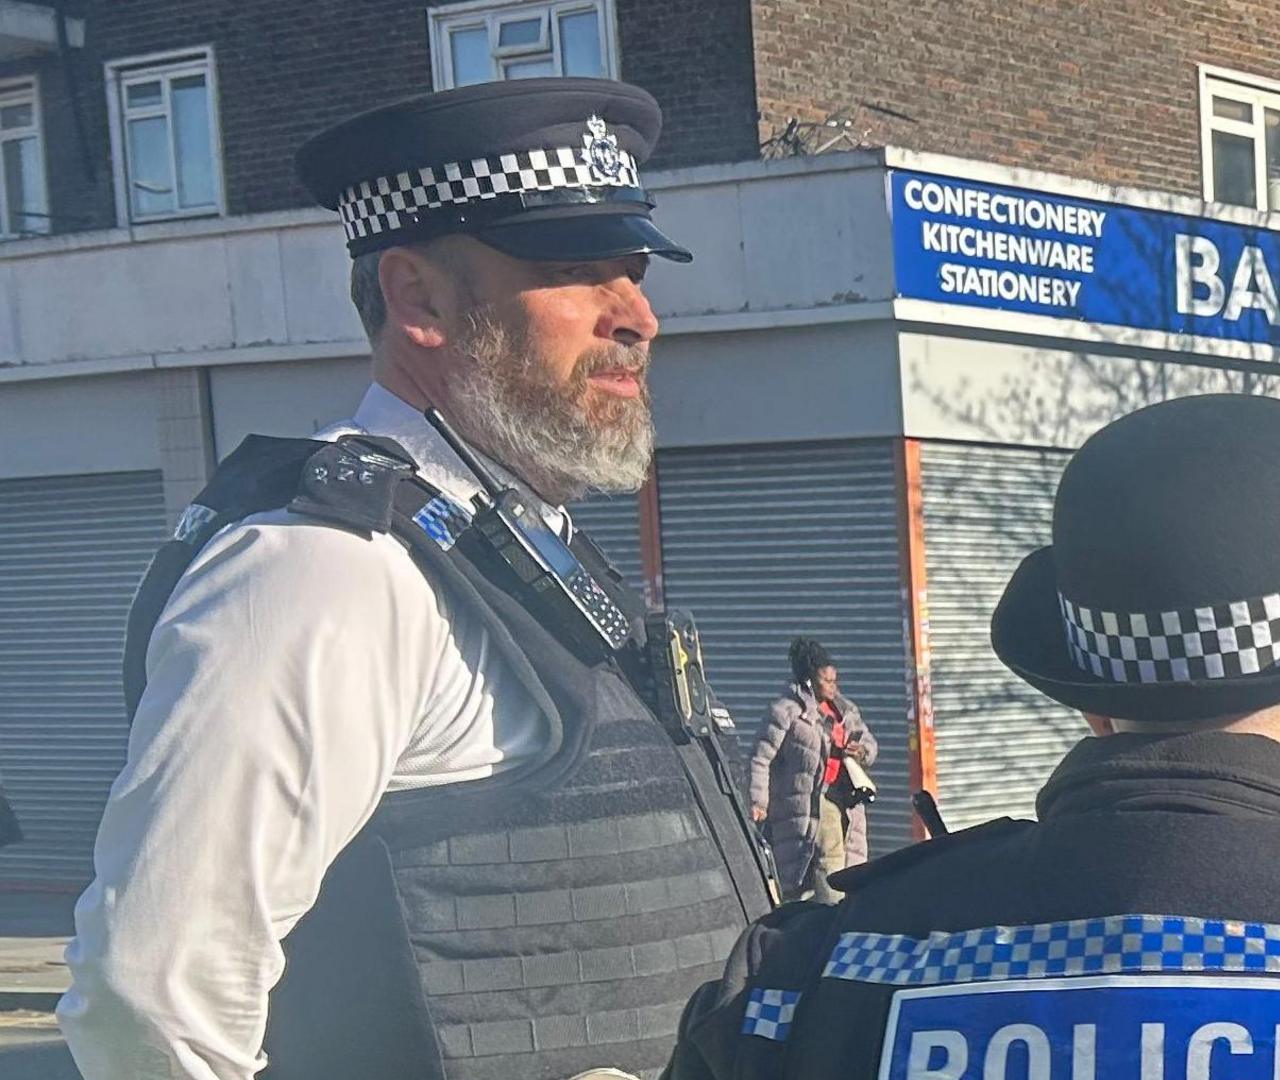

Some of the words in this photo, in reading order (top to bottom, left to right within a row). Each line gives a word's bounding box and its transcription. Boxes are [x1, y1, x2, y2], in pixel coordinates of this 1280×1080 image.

[904, 179, 1106, 237] CONFECTIONERY
[923, 221, 1094, 273] KITCHENWARE
[940, 263, 1082, 307] STATIONERY
